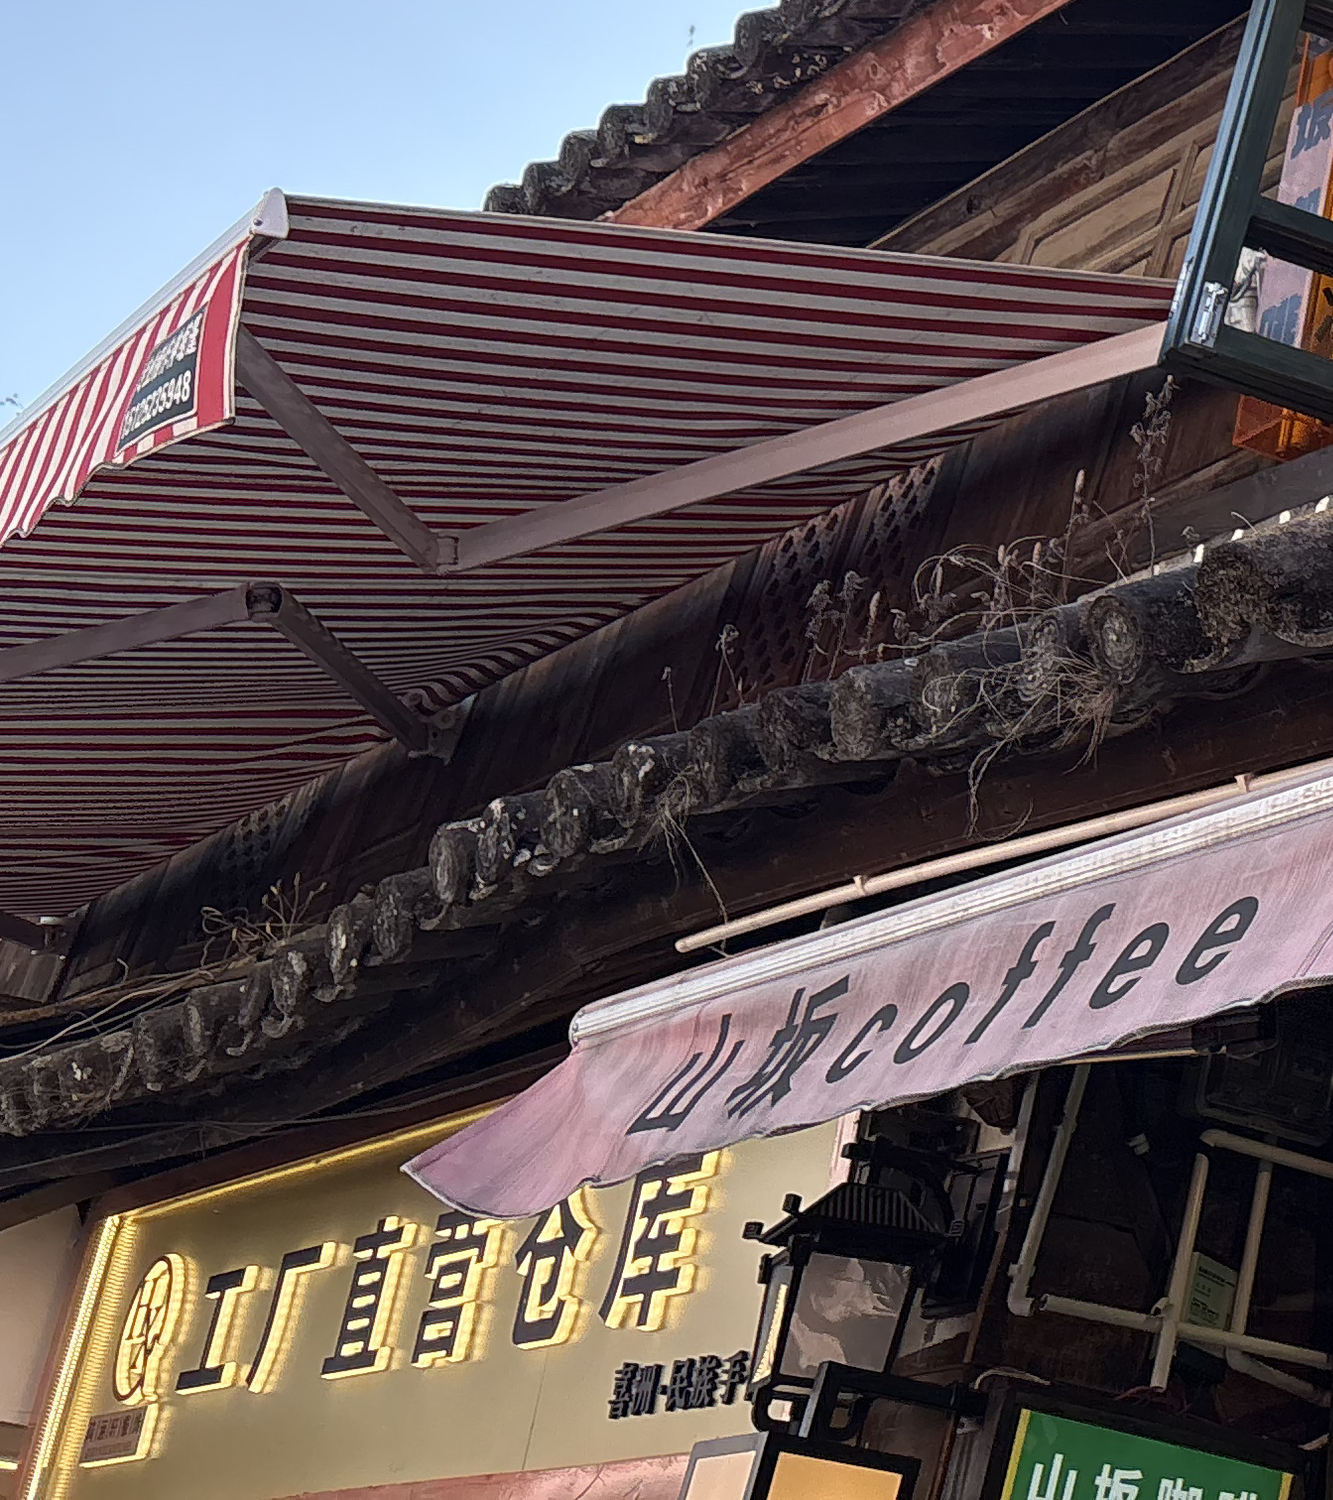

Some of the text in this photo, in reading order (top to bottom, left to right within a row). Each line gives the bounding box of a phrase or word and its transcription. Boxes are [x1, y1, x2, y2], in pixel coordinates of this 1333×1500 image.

[175, 1150, 720, 1396] 工厂直营仓库
[1026, 1452, 1258, 1500] 山坂
